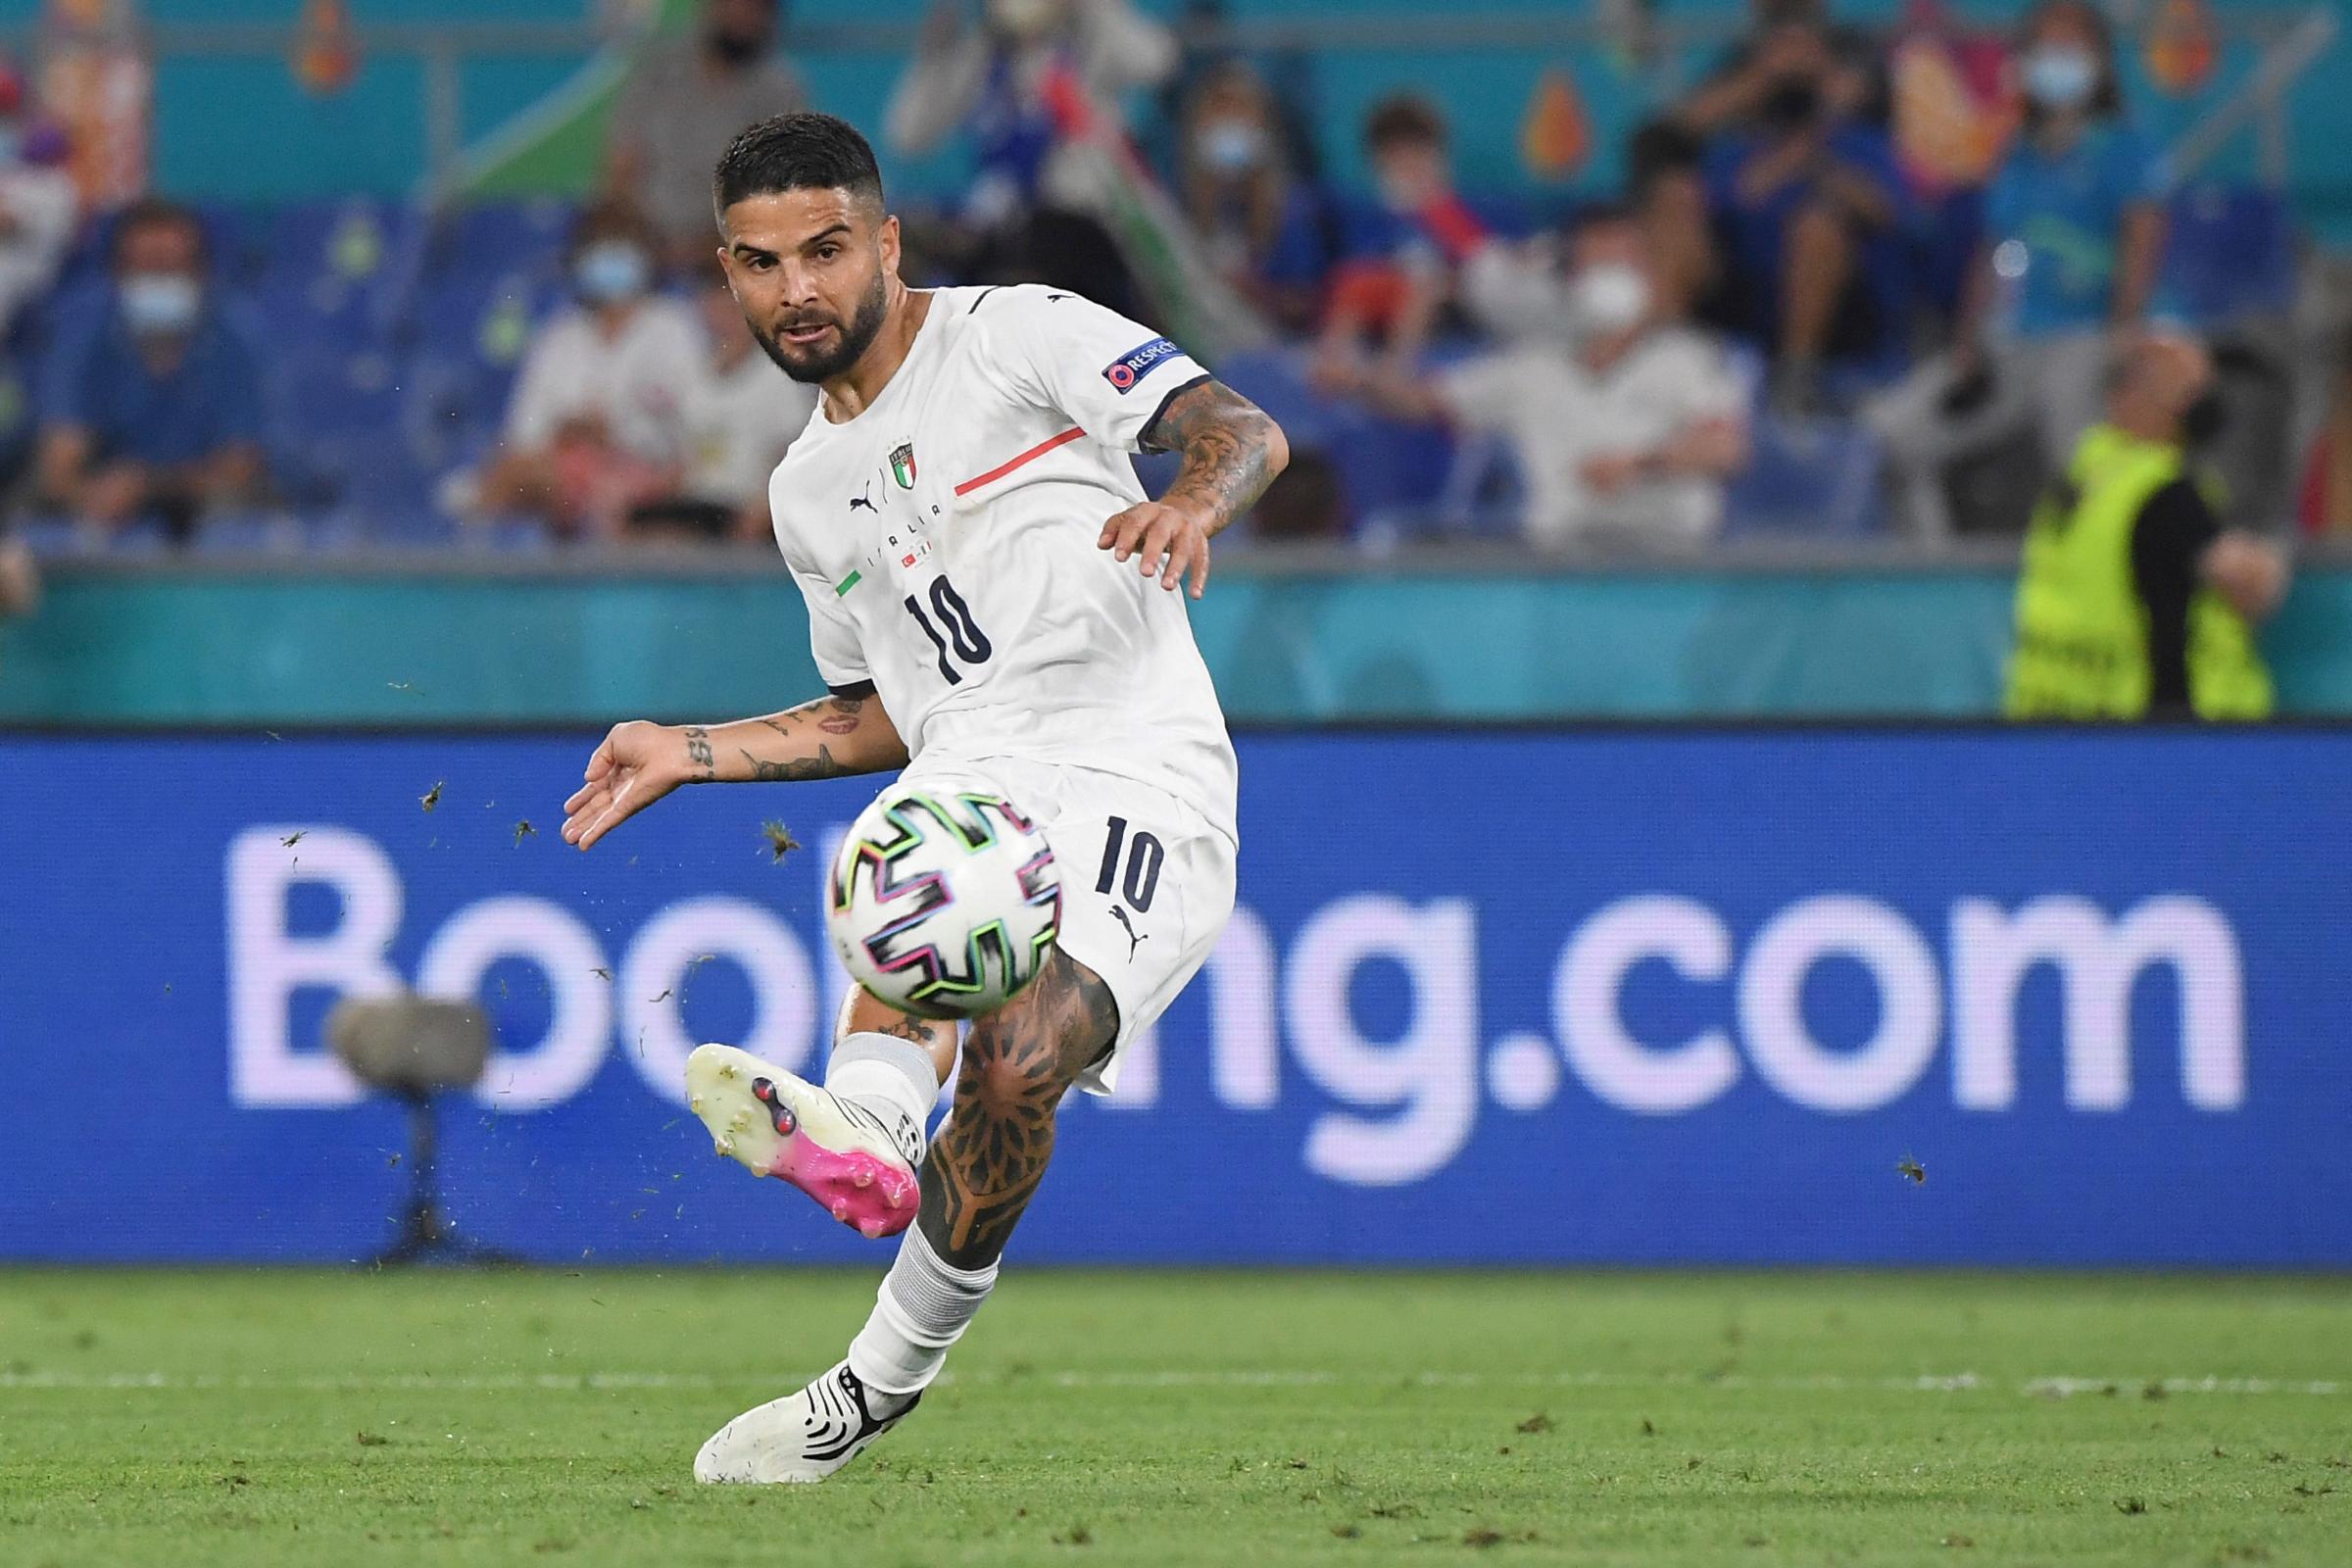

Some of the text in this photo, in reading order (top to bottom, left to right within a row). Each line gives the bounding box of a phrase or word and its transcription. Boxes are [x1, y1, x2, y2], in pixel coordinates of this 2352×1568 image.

[867, 504, 941, 567] ITALIA
[904, 573, 992, 686] 10
[1095, 815, 1164, 913] 10
[226, 825, 2244, 1184] Boong.com
